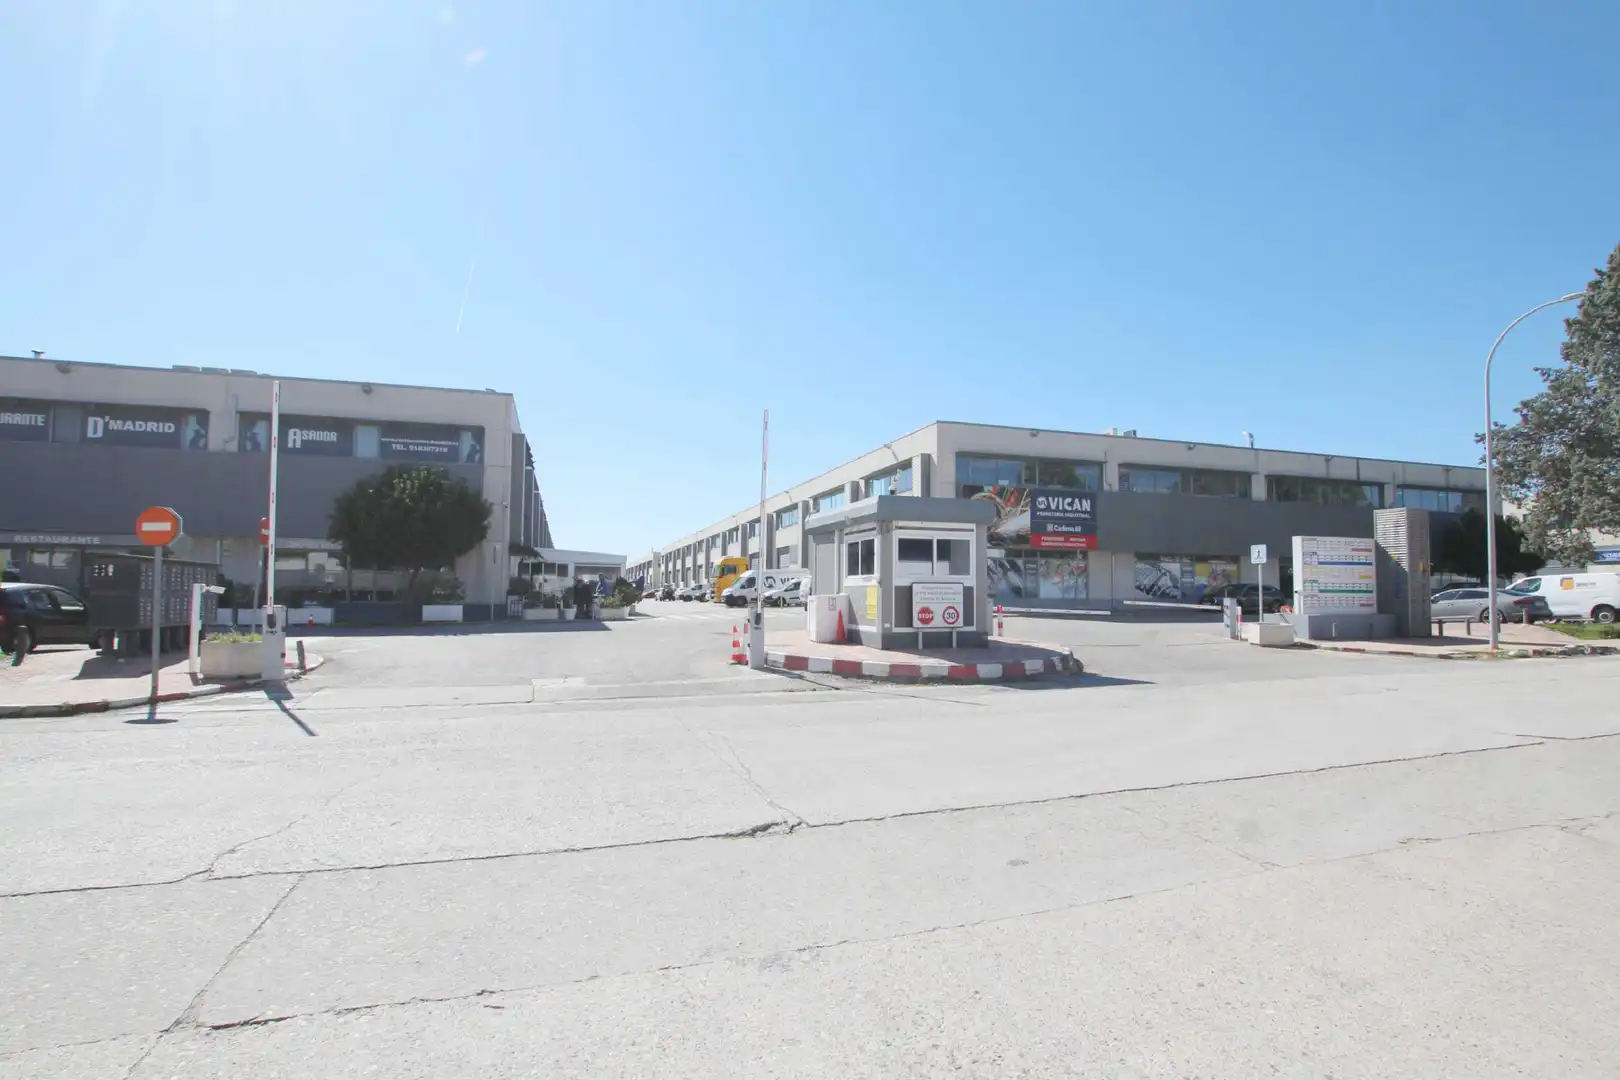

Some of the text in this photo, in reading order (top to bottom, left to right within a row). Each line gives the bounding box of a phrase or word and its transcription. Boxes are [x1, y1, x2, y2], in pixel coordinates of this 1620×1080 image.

[87, 415, 175, 438] D'MADRID
[1048, 496, 1091, 512] VICAN
[14, 535, 101, 544] RESTAURANTE
